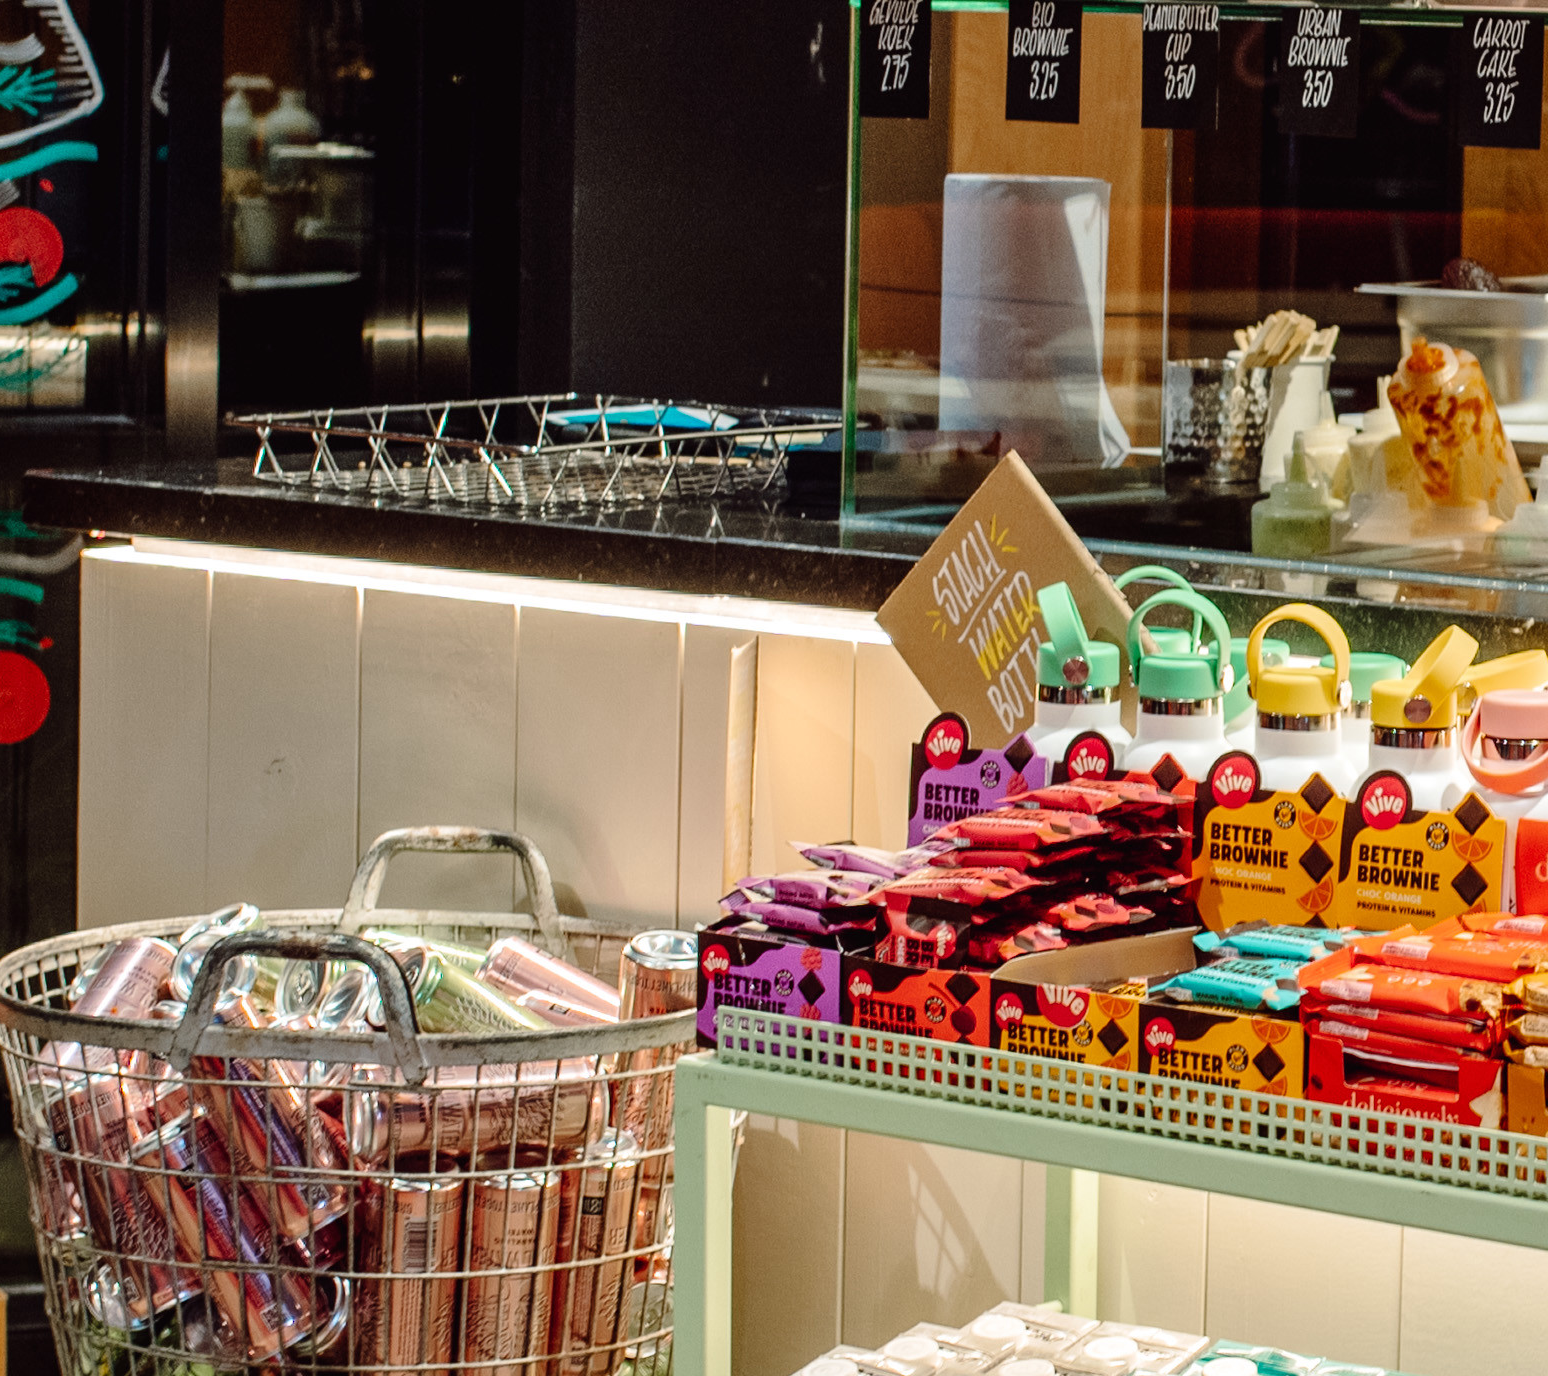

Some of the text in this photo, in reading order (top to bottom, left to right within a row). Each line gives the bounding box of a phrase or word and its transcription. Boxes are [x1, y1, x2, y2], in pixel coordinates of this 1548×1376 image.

[1032, 1, 1054, 27] BIO
[1297, 8, 1342, 37] URBAN
[878, 25, 913, 50] KOEK
[1013, 28, 1072, 57] BROWNIE
[1166, 33, 1192, 61] CUP
[1473, 18, 1530, 49] CARROT
[1288, 37, 1350, 67] BROWNIE
[1477, 49, 1520, 78] CAKE
[881, 54, 909, 92] 2.75
[1030, 62, 1059, 100] 3.25
[1165, 64, 1196, 100] 3.50
[1302, 70, 1333, 108] 3.50
[1483, 81, 1519, 124] 3.25
[933, 520, 1005, 625] STACH
[1364, 785, 1405, 816] Vive
[1359, 845, 1424, 868] BETTER
[1357, 866, 1440, 891] BROWNIE
